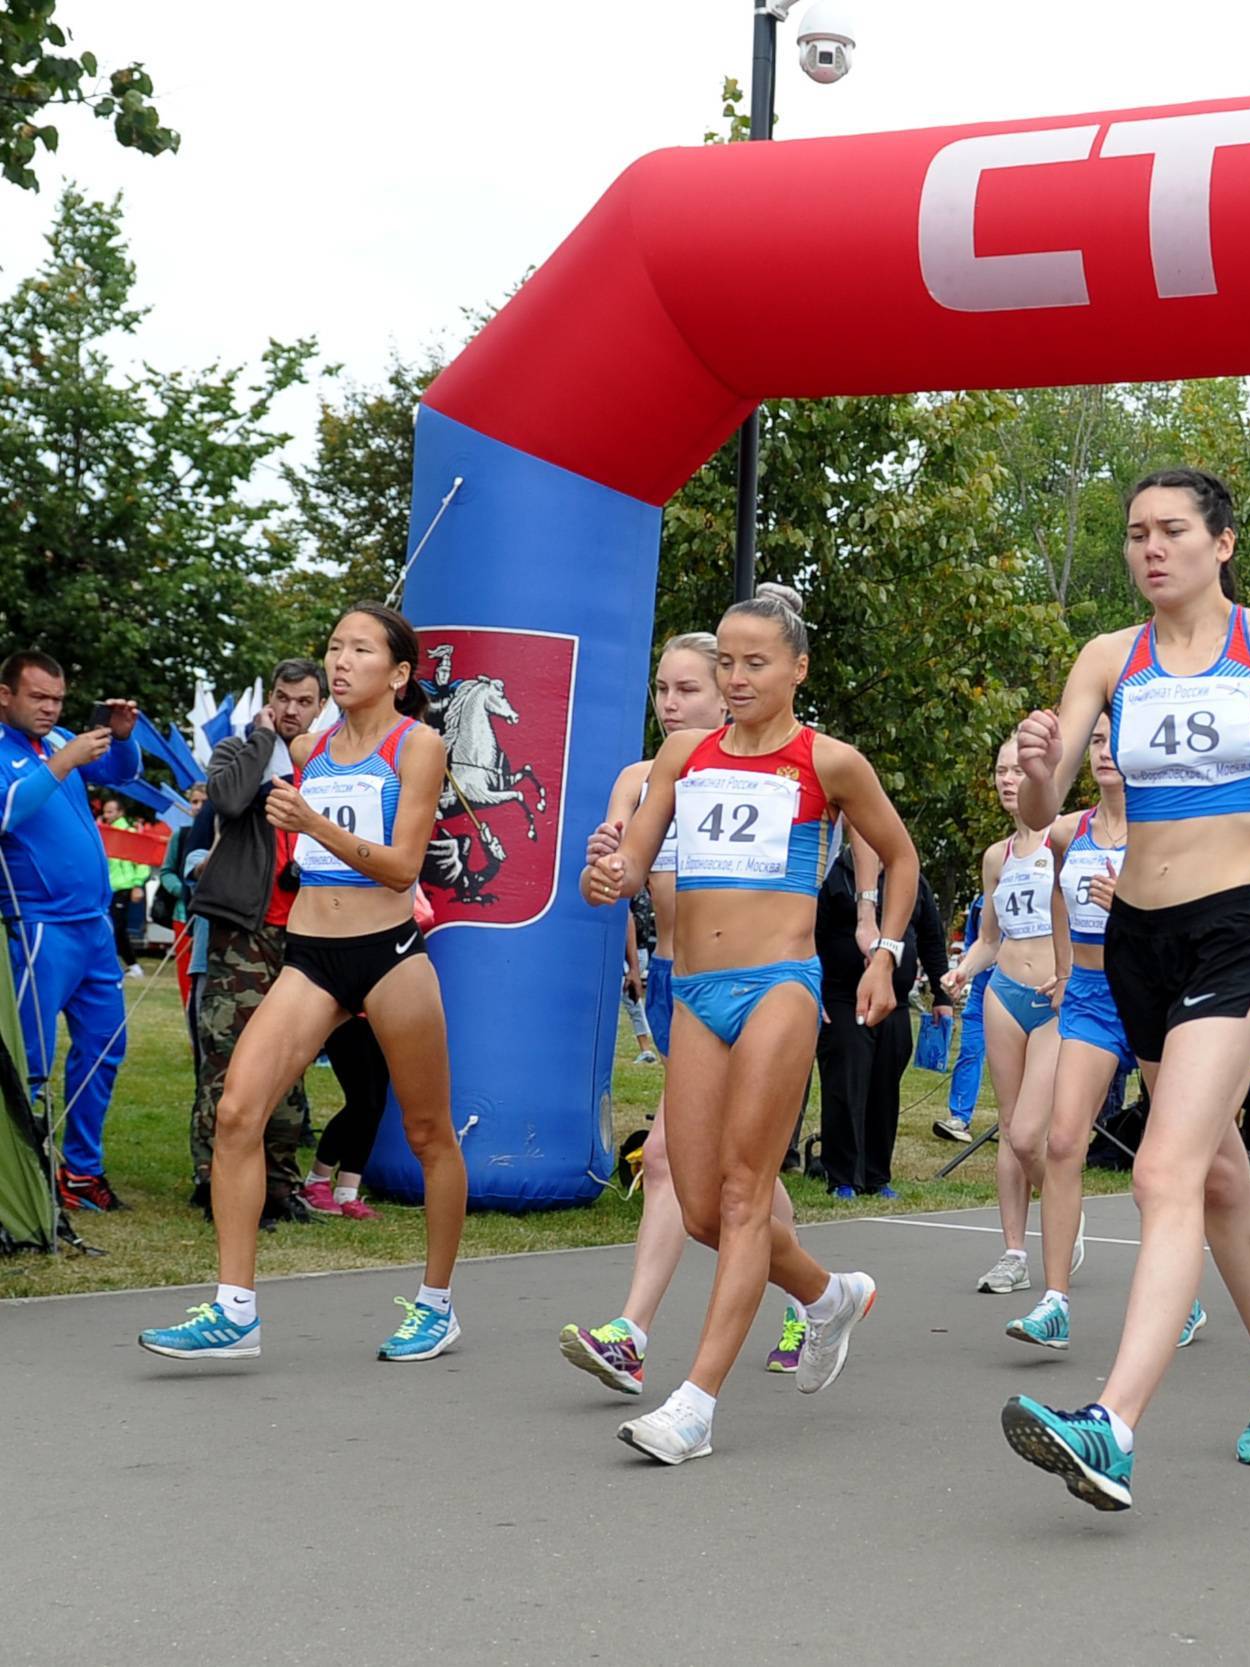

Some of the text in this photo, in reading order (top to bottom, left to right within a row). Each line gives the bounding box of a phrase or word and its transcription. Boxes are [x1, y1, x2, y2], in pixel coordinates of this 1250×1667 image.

[1149, 710, 1220, 755] 48
[697, 803, 759, 843] 42
[747, 856, 782, 873] Москва
[1005, 890, 1035, 916] 47
